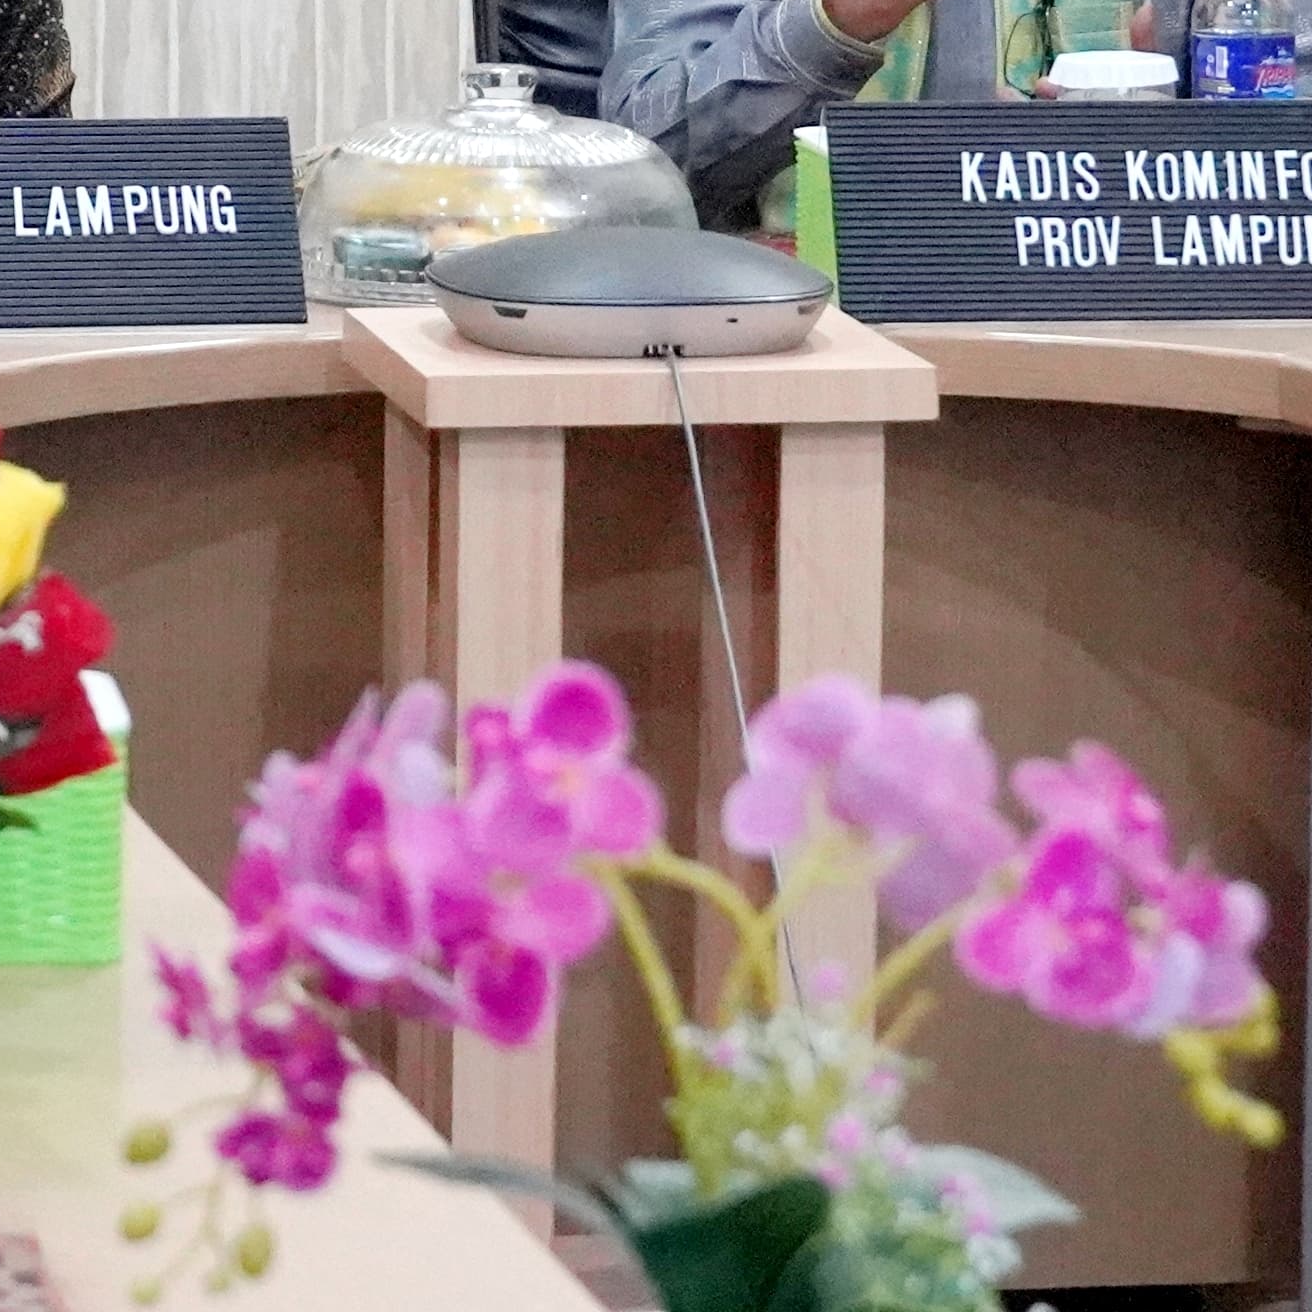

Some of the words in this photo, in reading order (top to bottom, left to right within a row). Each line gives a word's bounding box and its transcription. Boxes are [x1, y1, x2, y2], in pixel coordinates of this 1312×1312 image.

[960, 150, 1101, 203] KADIS
[13, 184, 238, 237] LAMPUNG
[1014, 215, 1121, 268] PROV
